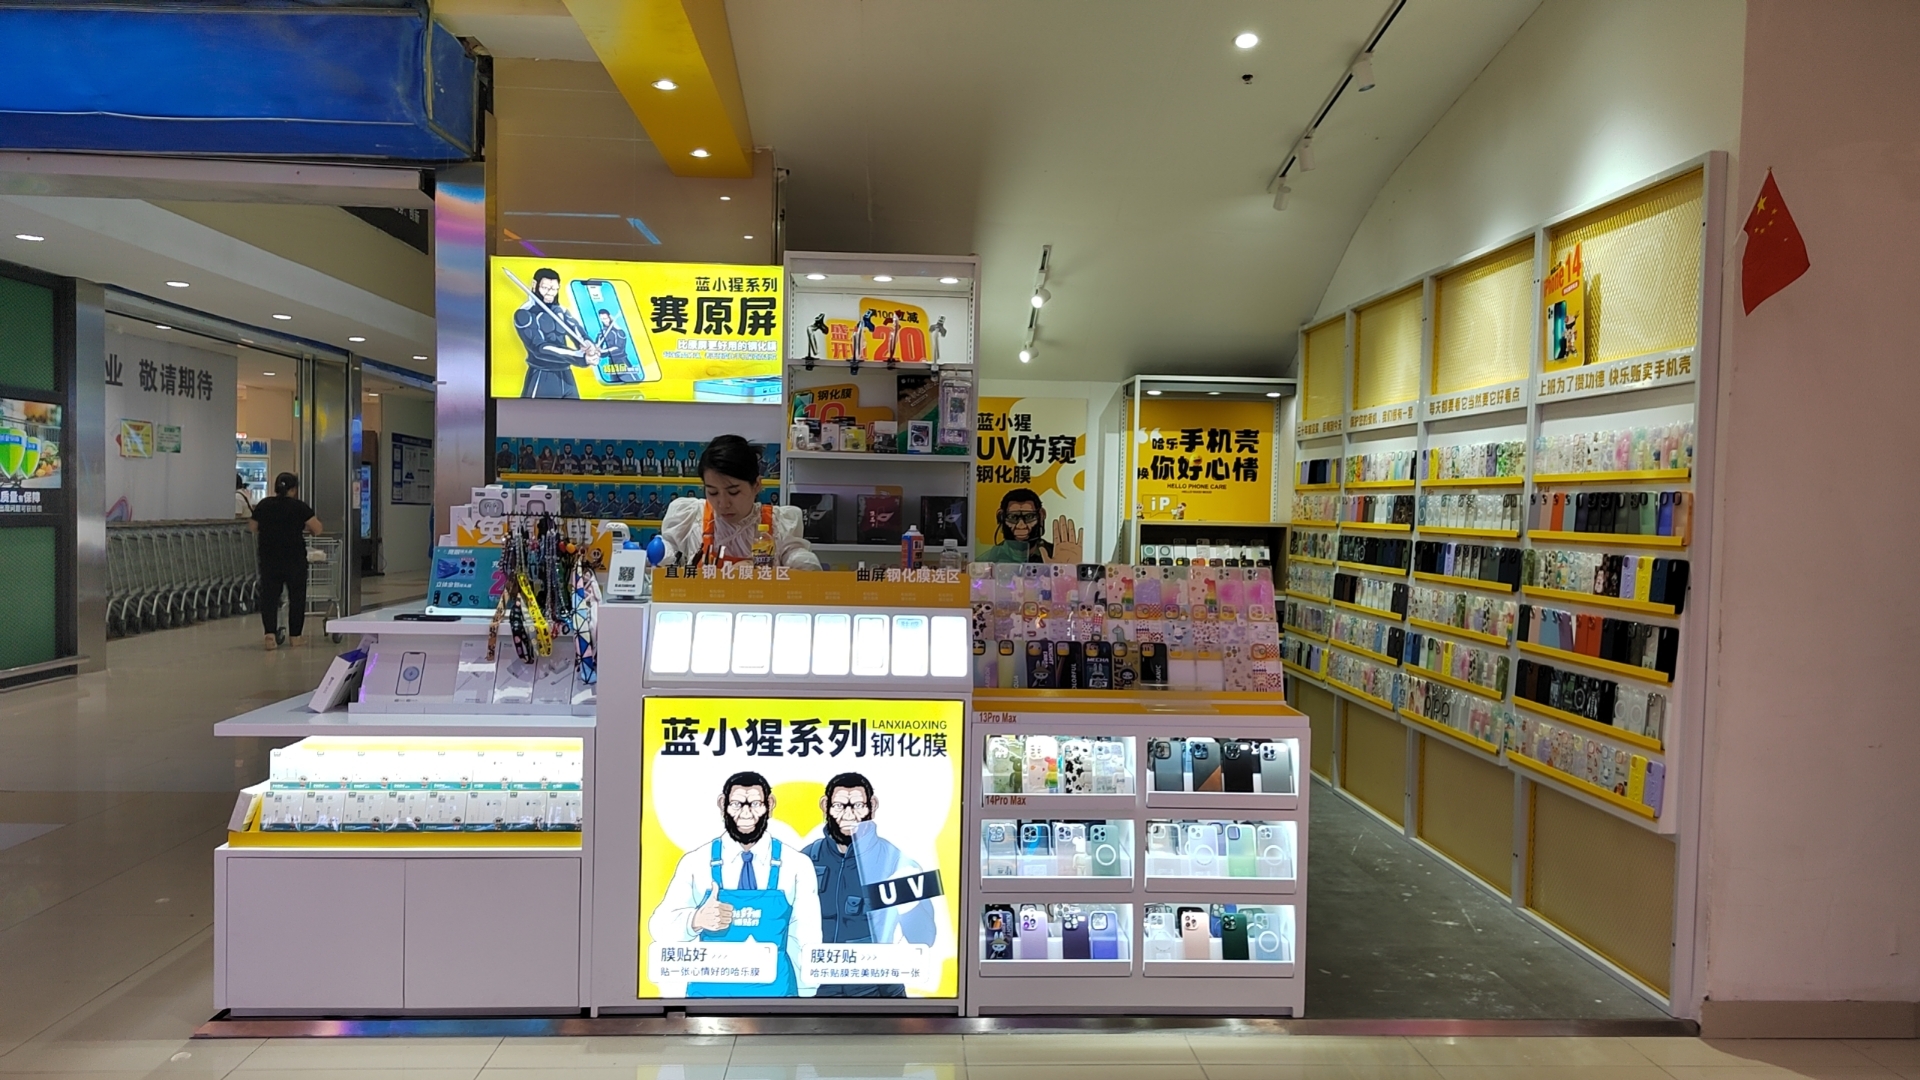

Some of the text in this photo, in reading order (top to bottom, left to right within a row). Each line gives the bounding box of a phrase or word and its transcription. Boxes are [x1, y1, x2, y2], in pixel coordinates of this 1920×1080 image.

[1566, 243, 1581, 283] 14
[695, 276, 778, 293] 蓝小猩系列
[650, 296, 777, 336] 赛原屏
[139, 358, 213, 401] 敬请期待
[1538, 354, 1692, 397] 上班为了攒功德 快乐贩卖手机壳
[817, 388, 852, 401] 钢化膜
[976, 412, 1032, 432] 蓝小猩
[976, 434, 1077, 465] UV防窥
[976, 465, 1032, 484] 钢化膜
[665, 561, 790, 580] 直屏钢化膜选区
[857, 567, 960, 583] 曲屏钢化膜选区
[872, 719, 948, 730] LANXIAOXING
[979, 712, 1017, 723] 13Pro Max
[661, 717, 867, 757] 蓝小猩系列
[870, 733, 948, 758] 钢化膜
[985, 795, 1026, 806] 14Pro Max
[661, 947, 708, 962] 膜贴好
[810, 949, 857, 963] 膜好贴
[660, 967, 760, 977] 贴一张心情好的哈乐膜
[810, 968, 920, 978] 哈乐贴膜完美贴好每一张
